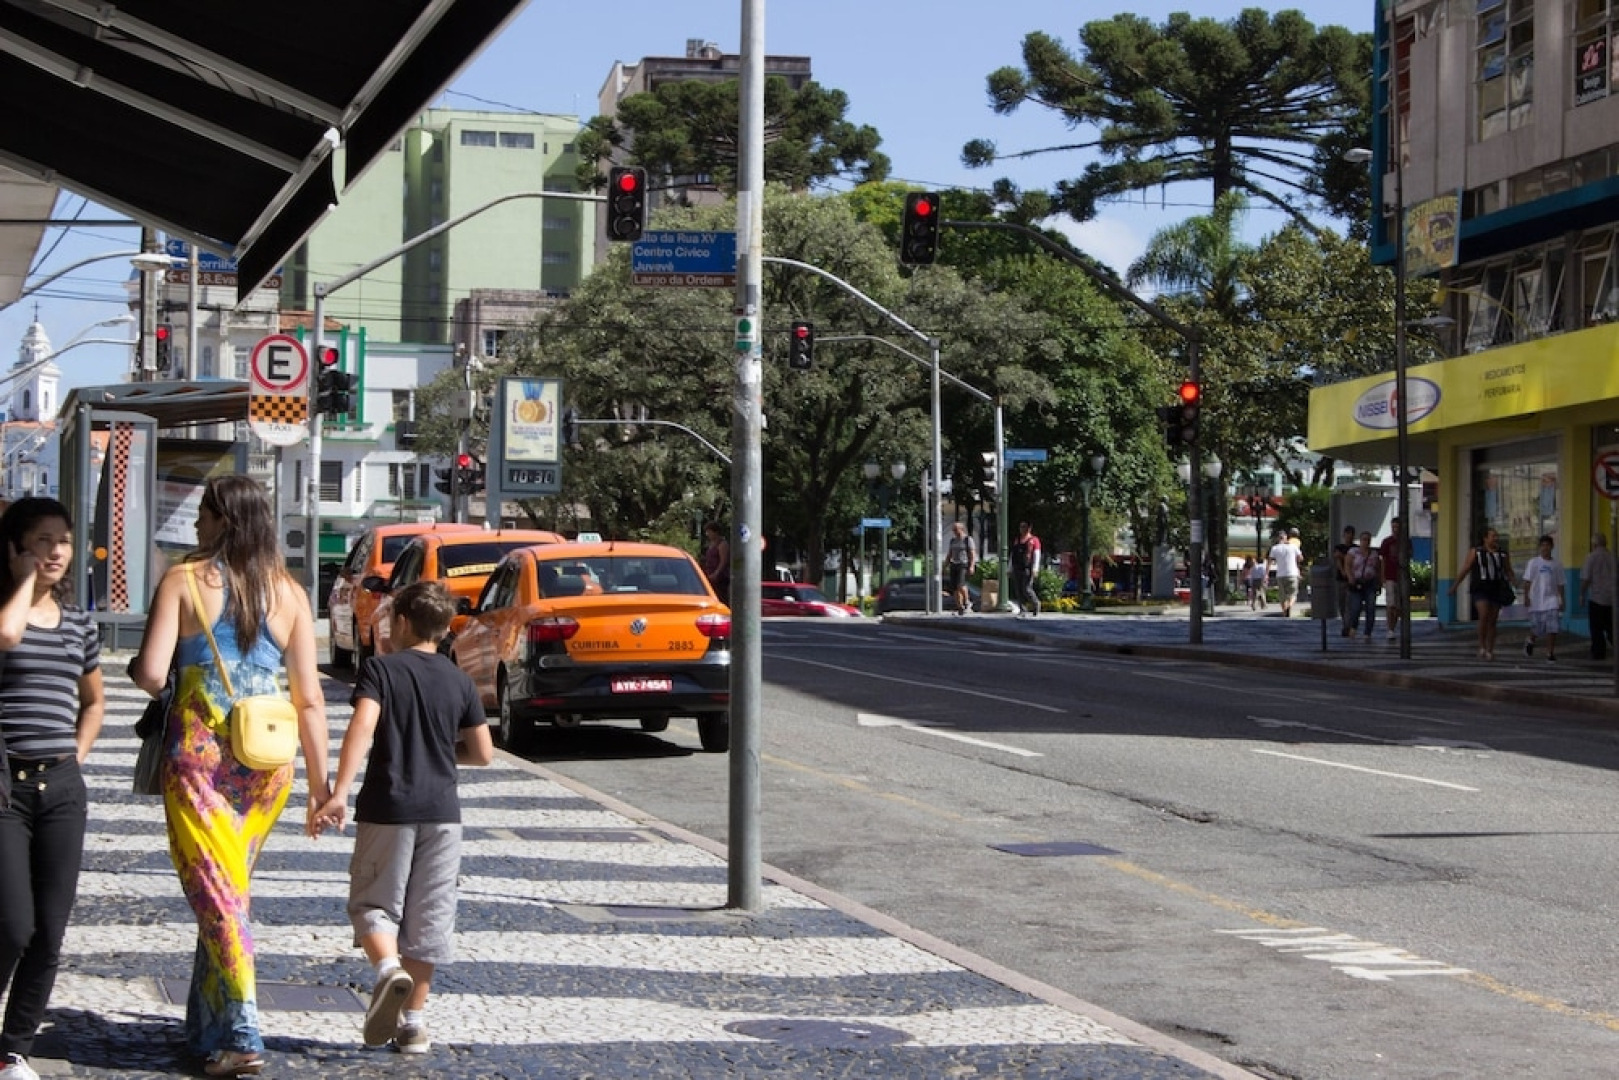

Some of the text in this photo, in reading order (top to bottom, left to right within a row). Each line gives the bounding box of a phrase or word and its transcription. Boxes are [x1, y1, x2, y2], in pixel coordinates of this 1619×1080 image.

[677, 233, 698, 243] Rua
[701, 233, 717, 243] XV
[634, 246, 672, 257] Centro
[634, 275, 667, 286] Largo
[686, 275, 724, 285] Ordem
[267, 346, 292, 380] E
[572, 641, 619, 650] CURITIBA
